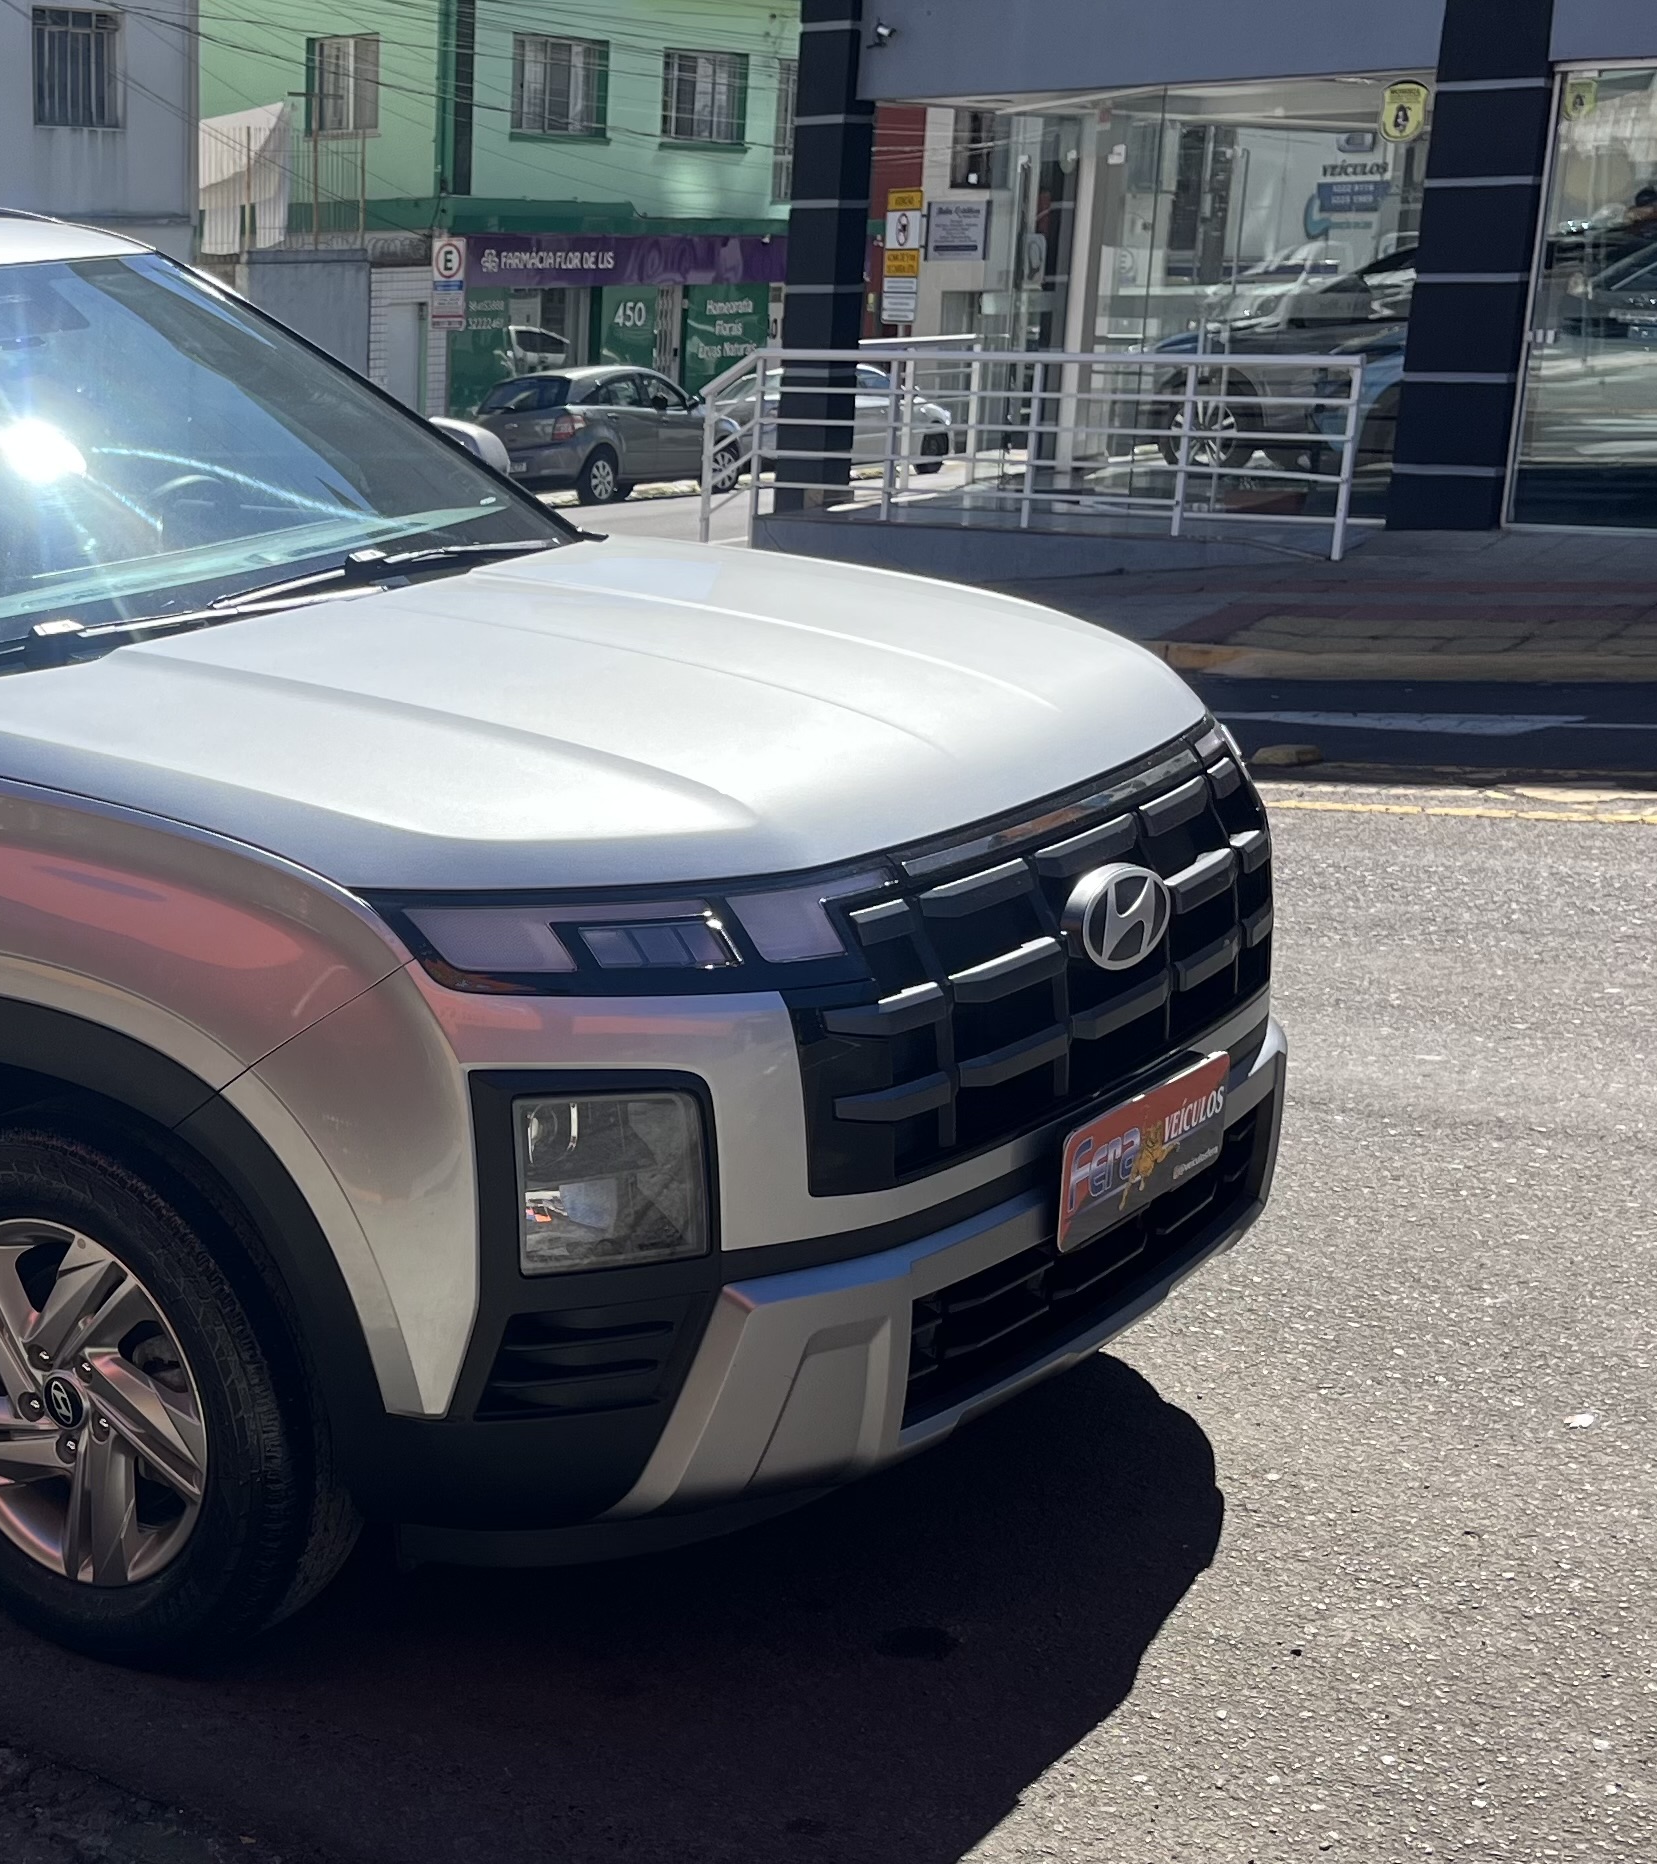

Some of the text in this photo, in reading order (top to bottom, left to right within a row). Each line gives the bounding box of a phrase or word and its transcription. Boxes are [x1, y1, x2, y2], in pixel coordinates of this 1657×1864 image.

[1322, 159, 1389, 177] VEÍCULOS
[444, 250, 453, 271] E
[501, 246, 615, 269] FARMÁCIA FLOR DE LIS
[614, 301, 646, 327] 450
[715, 319, 743, 336] Florais
[1162, 1085, 1225, 1143] VEÍCULOS
[1067, 1127, 1141, 1213] Fera
